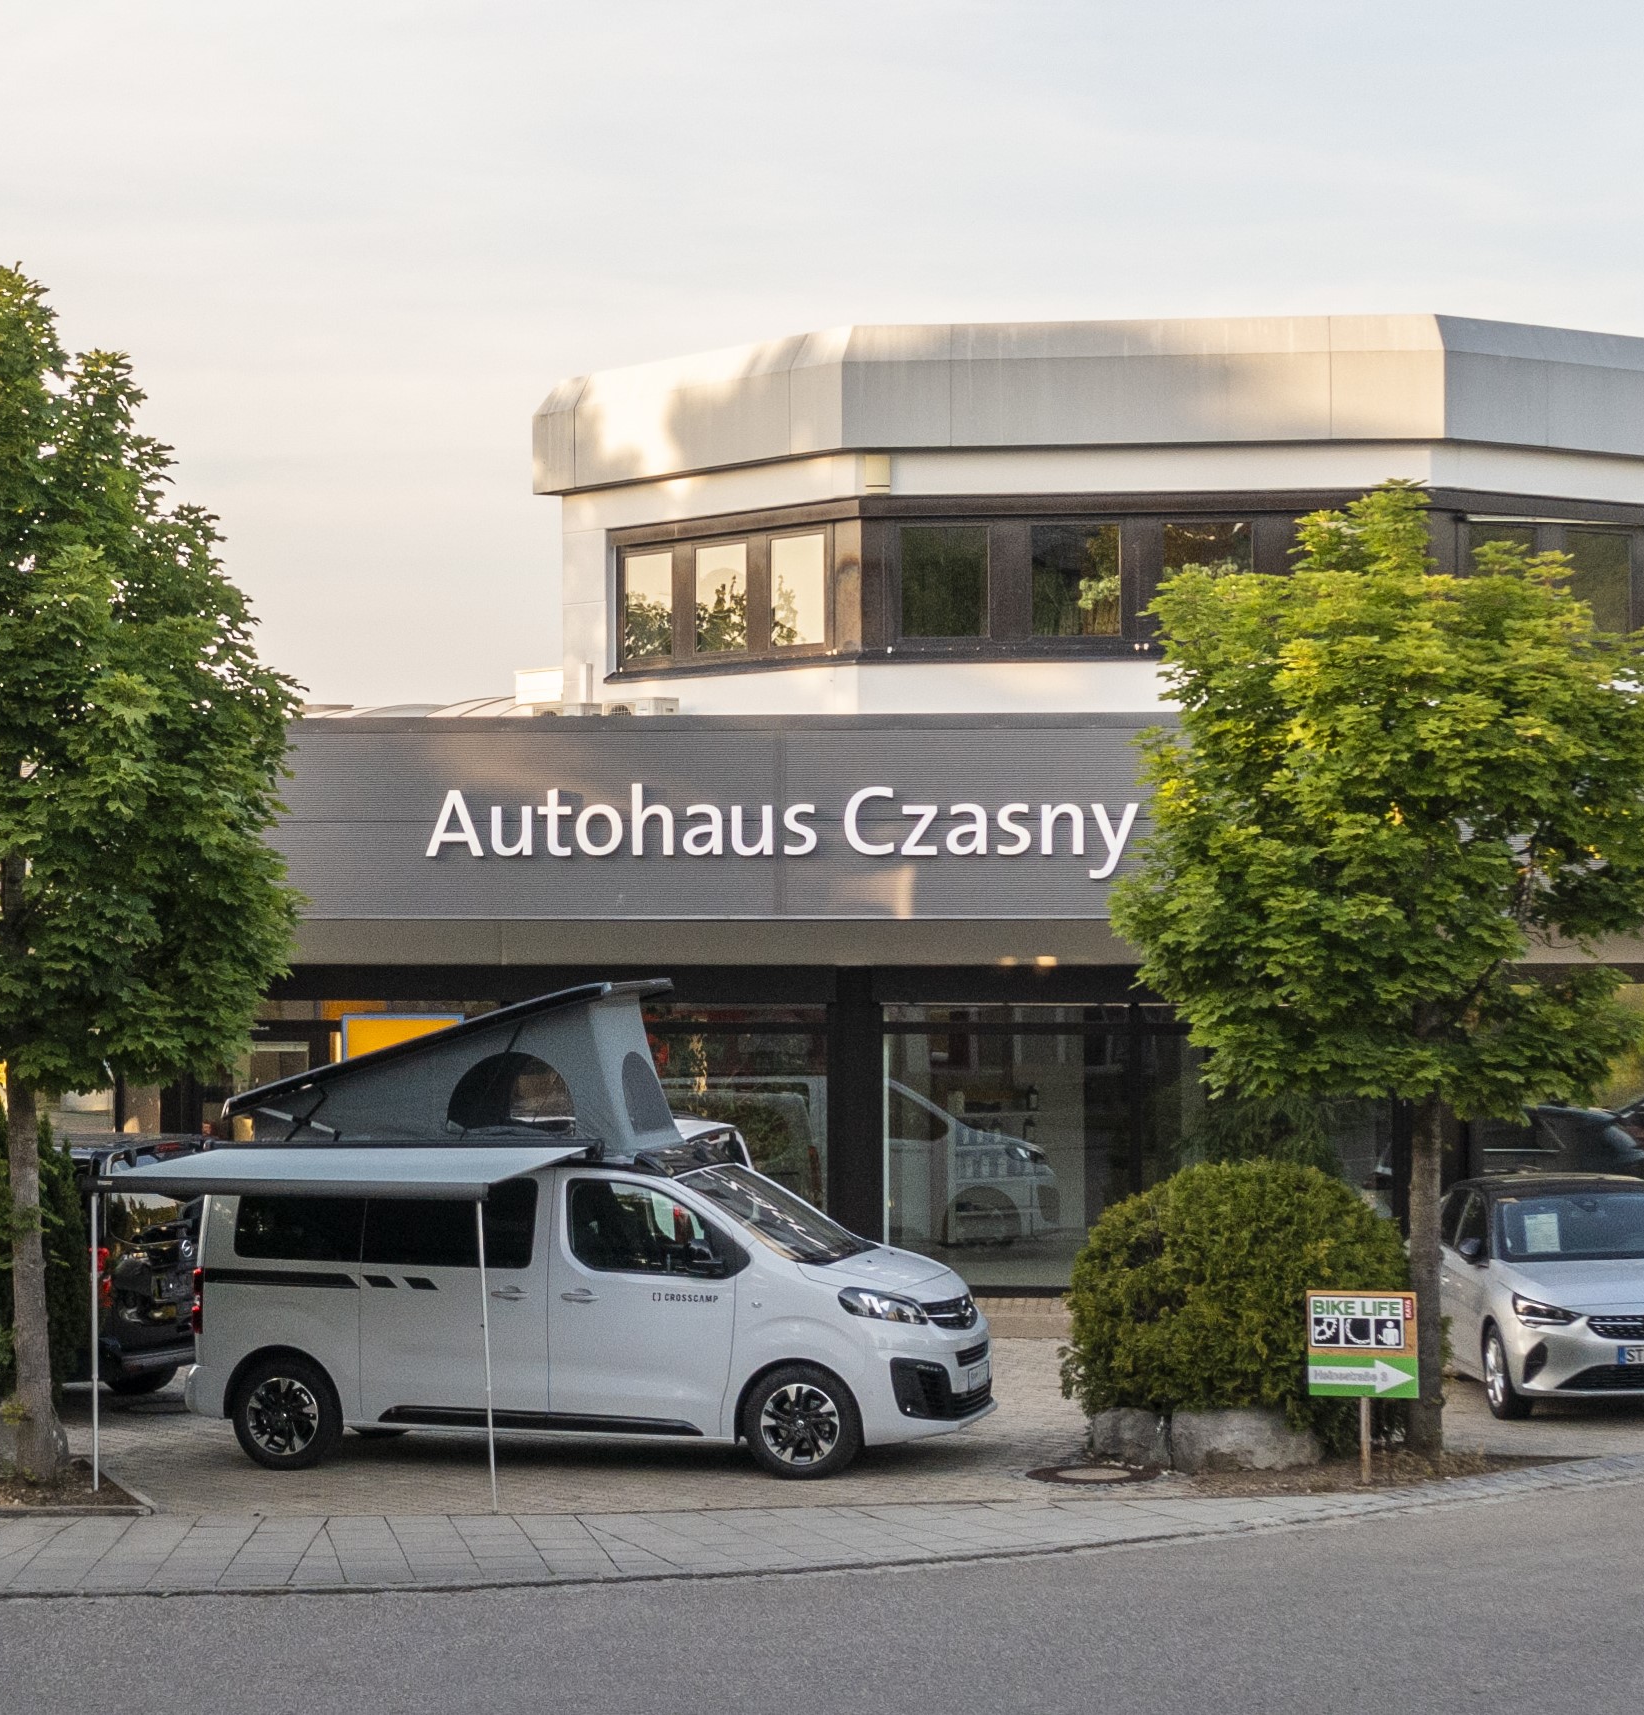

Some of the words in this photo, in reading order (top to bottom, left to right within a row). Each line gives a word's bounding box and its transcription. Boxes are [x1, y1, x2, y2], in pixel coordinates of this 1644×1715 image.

[425, 784, 816, 859] Autohaus
[842, 786, 1140, 880] Czasny
[664, 1293, 719, 1303] CROSSCAMP
[1312, 1300, 1355, 1316] BIKE
[1361, 1301, 1401, 1317] LIFE
